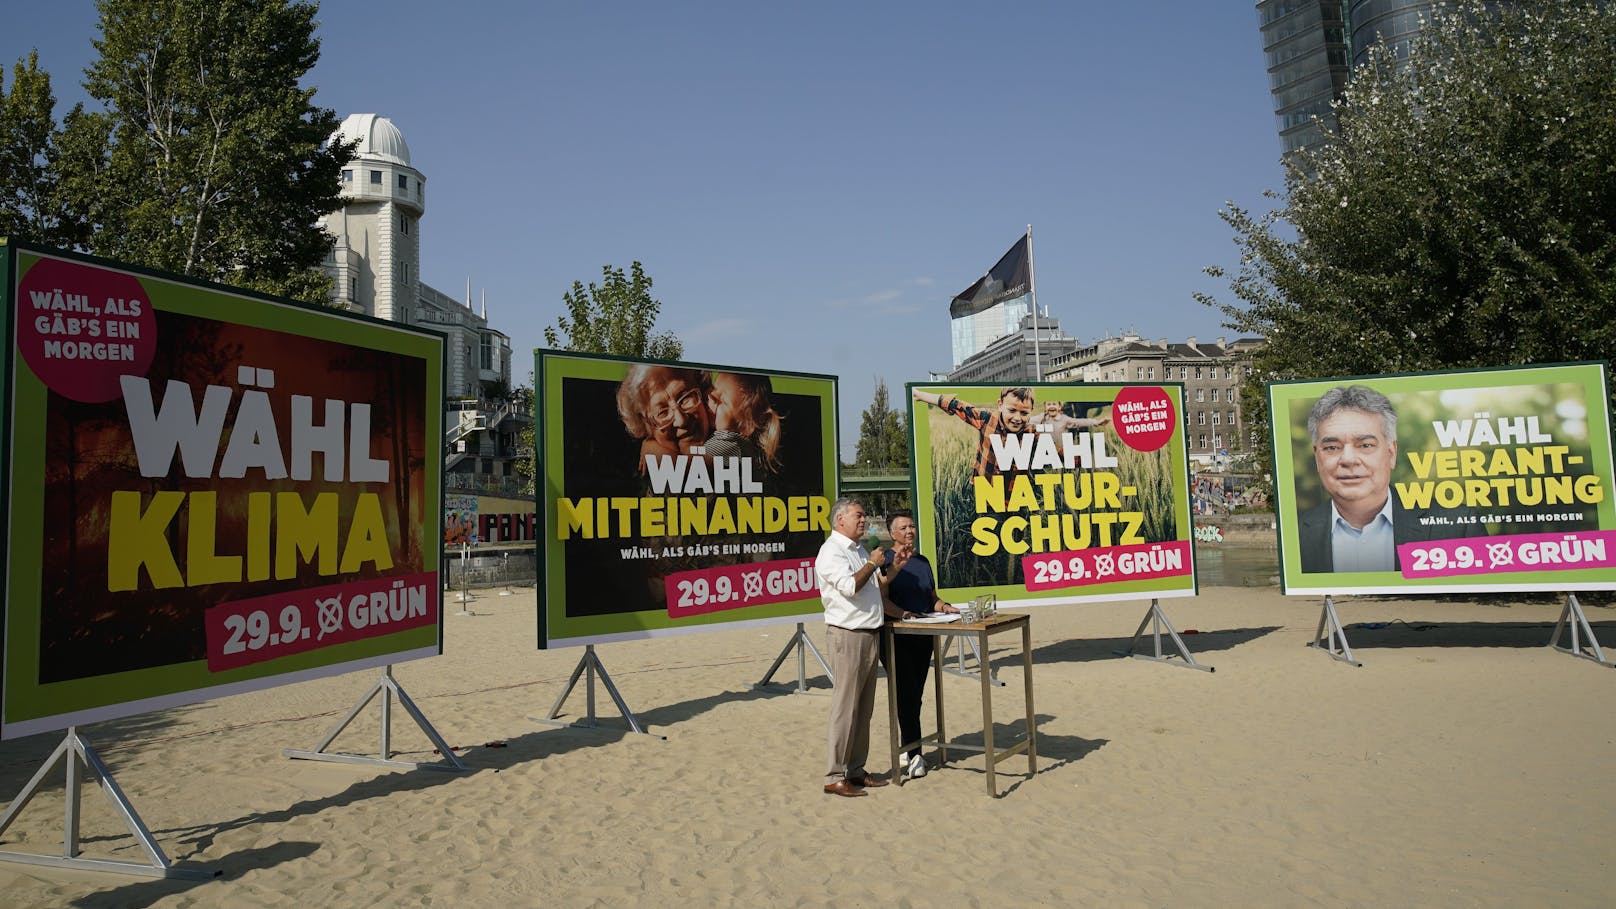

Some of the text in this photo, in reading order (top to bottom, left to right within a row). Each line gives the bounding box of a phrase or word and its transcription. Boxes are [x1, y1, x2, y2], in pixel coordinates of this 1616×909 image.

[29, 289, 141, 317] WÄHL, ALS
[106, 321, 140, 339] EIN
[44, 341, 134, 361] MORGEN
[120, 365, 390, 483] WÄHL
[1118, 400, 1167, 413] WÄHL, ALS
[1151, 410, 1167, 421] EIN
[1126, 422, 1166, 434] MORGEN
[1433, 412, 1551, 448] WÄHL
[990, 424, 1118, 470] WÄHL
[1407, 445, 1584, 479] VERANT-
[645, 446, 763, 494] WÄHL
[973, 472, 1137, 513] NATUR-
[1395, 475, 1604, 510] WORTUNG
[557, 496, 831, 540] MITEINANDER
[971, 512, 1145, 556] SCHUTZ
[1420, 516, 1453, 526] WÄHL,
[1457, 515, 1477, 524] ALS
[1515, 513, 1534, 522] EIN
[1537, 512, 1583, 522] MORGEN
[108, 491, 394, 593] KLIMA
[620, 546, 659, 560] WÄHL,
[662, 546, 684, 558] ALS
[722, 544, 740, 555] EIN
[743, 542, 785, 554] MORGEN
[1411, 535, 1606, 571] 29.9. GRÜN
[1033, 545, 1182, 583] 29.9. GRÜN
[677, 576, 739, 607] 29.9.
[223, 580, 427, 655] 29.9. GRÜN
